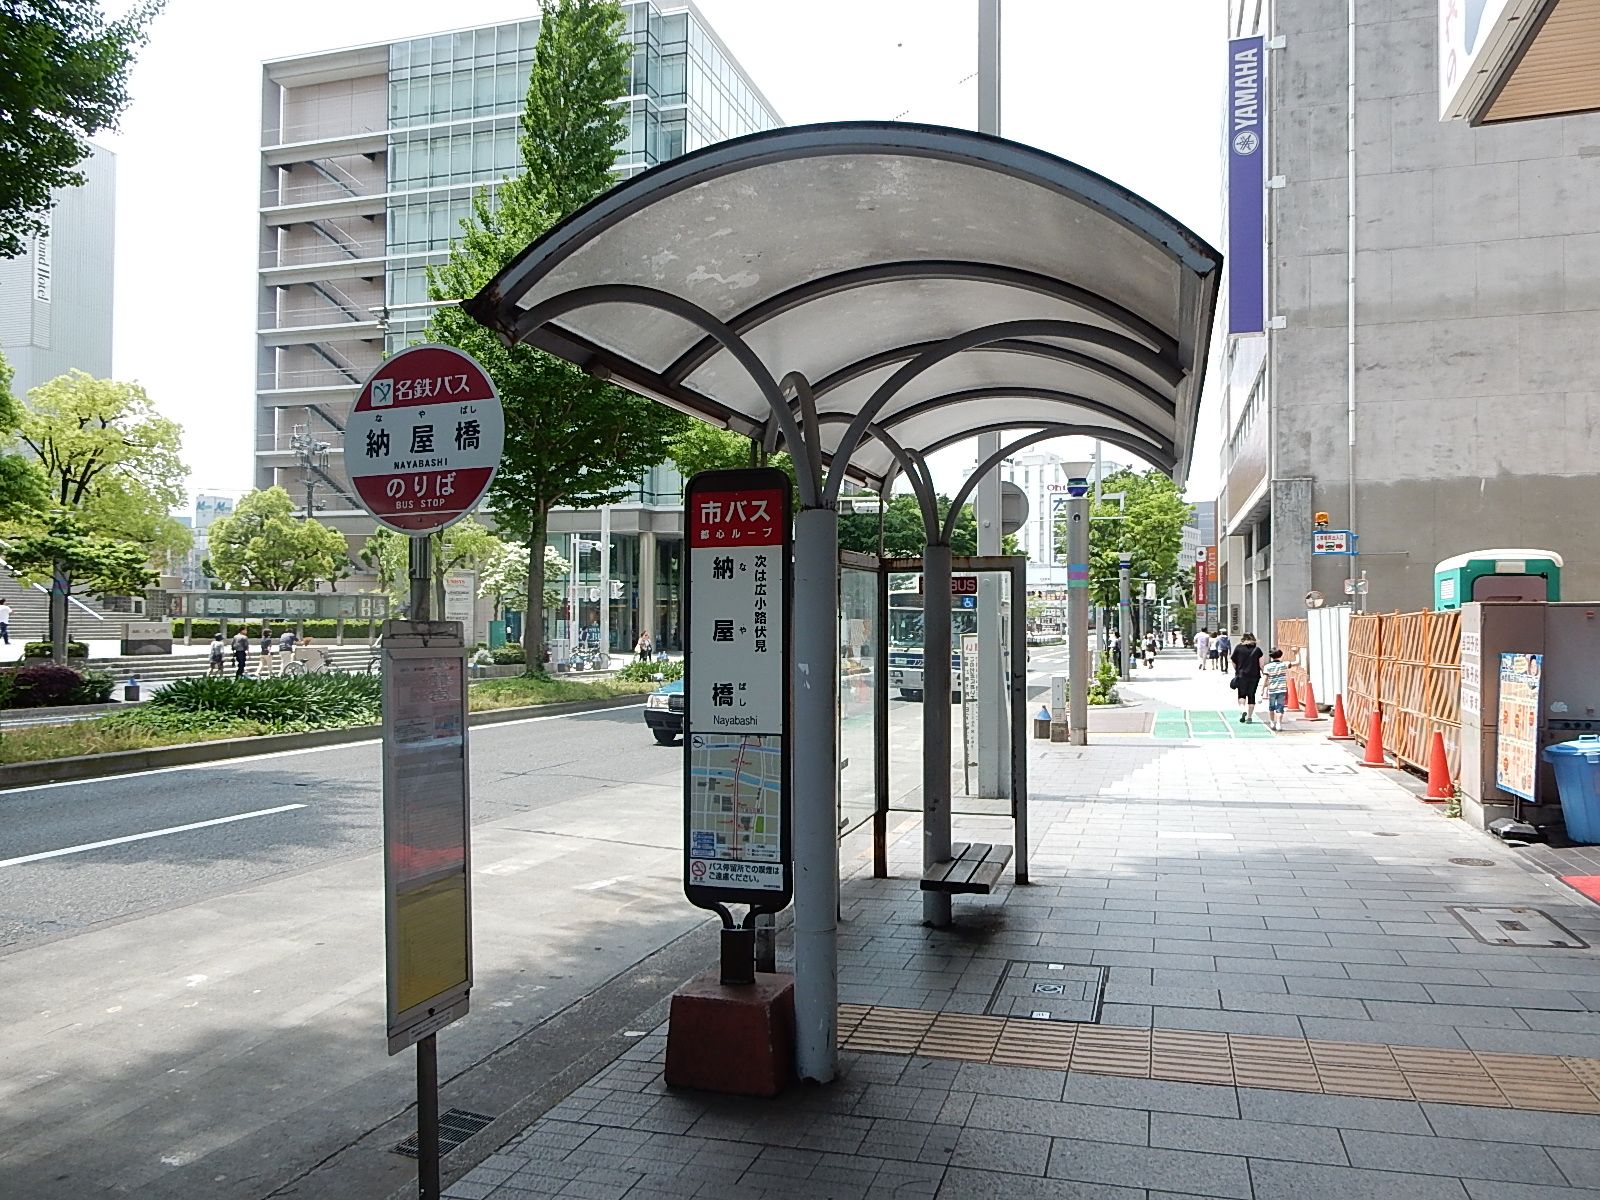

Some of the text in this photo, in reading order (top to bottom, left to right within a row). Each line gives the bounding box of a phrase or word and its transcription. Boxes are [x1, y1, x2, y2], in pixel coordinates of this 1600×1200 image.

[1234, 47, 1258, 131] YAMAHA
[37, 268, 50, 302] Hotel
[395, 374, 470, 401] 名鉄バス
[460, 405, 477, 415] ばし
[365, 419, 481, 459] 納屋橋
[394, 457, 448, 470] NAYABASHI
[386, 472, 457, 499] のりば
[395, 498, 445, 510] BUS STOP
[700, 500, 771, 525] 市バス
[700, 528, 773, 540] 都心ループ
[951, 579, 976, 592] BUS
[754, 554, 767, 653] 次は広小路伏見
[712, 556, 734, 707] 納屋橋
[713, 714, 758, 726] Nayabashi
